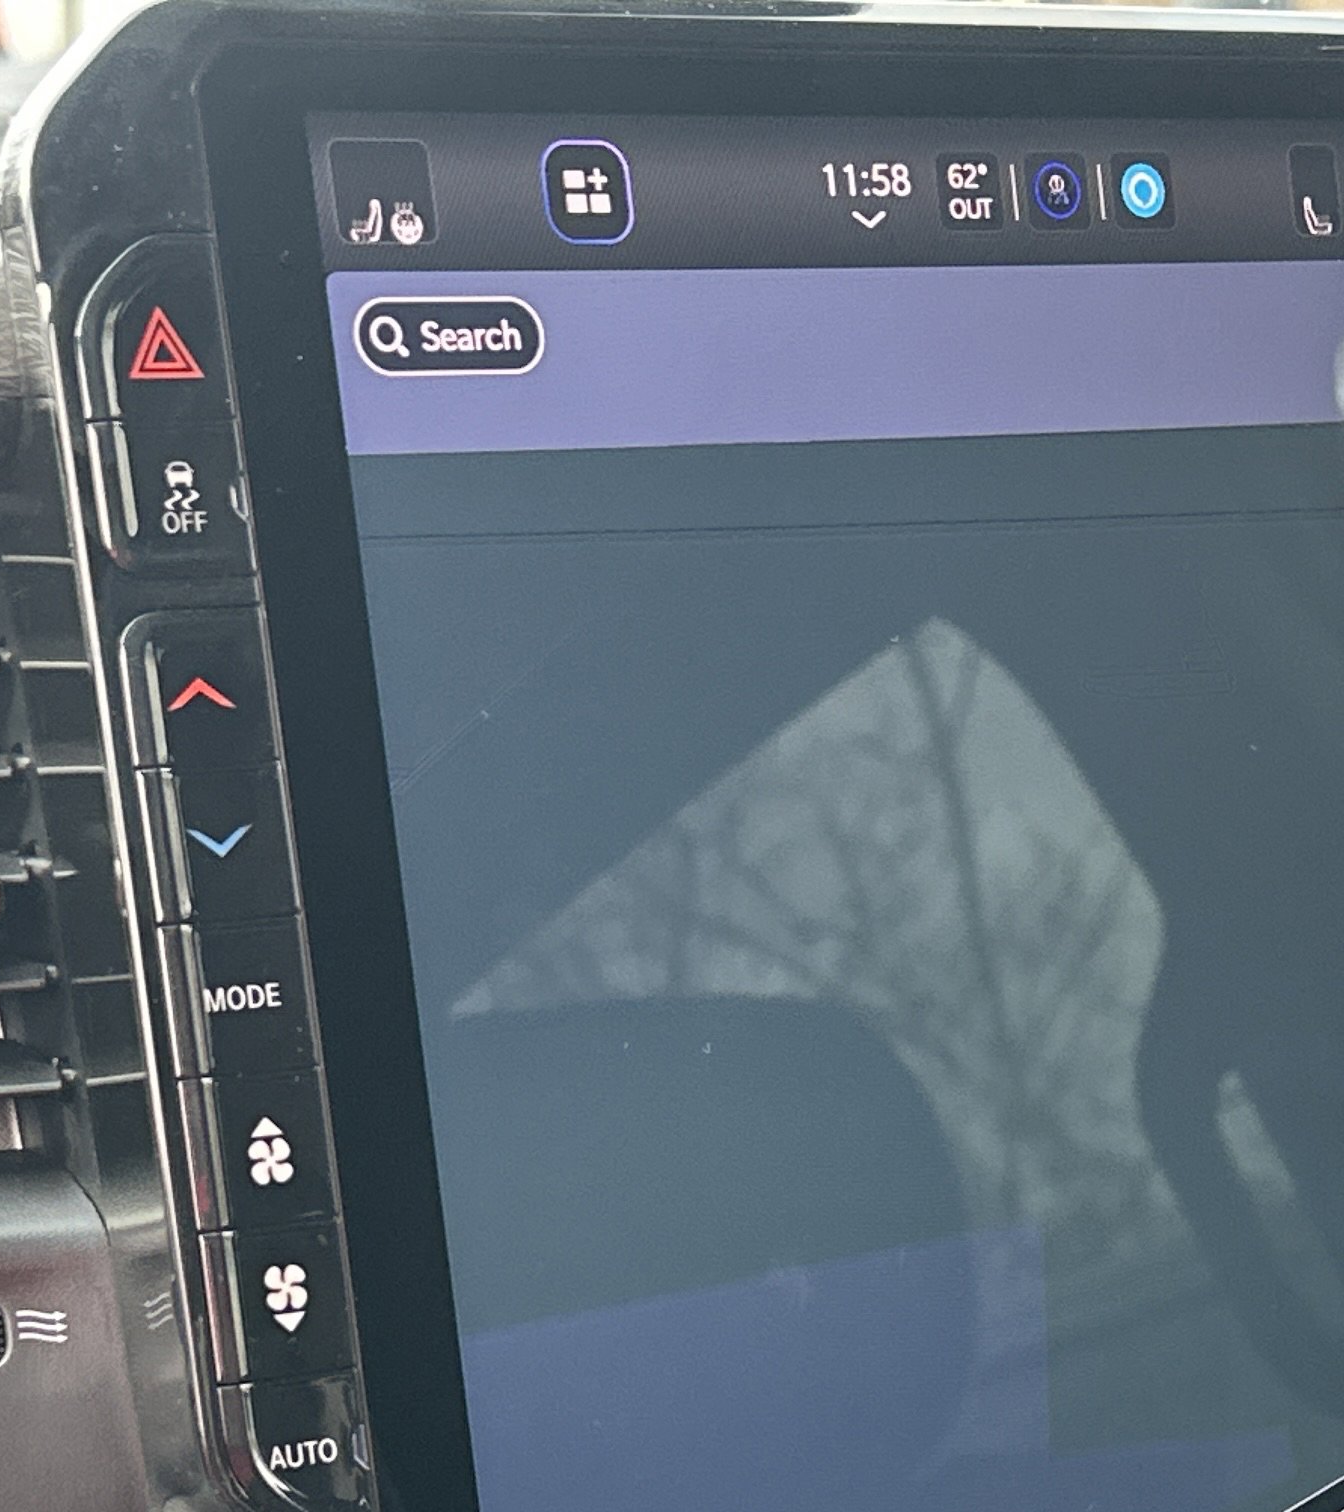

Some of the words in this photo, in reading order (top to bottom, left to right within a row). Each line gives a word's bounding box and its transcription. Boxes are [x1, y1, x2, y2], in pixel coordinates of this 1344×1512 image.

[822, 163, 912, 197] 11:58
[948, 197, 994, 220] OUT
[419, 318, 523, 352] Search
[161, 510, 208, 534] OFF
[202, 982, 282, 1013] MODE
[269, 1437, 338, 1470] AUTO
